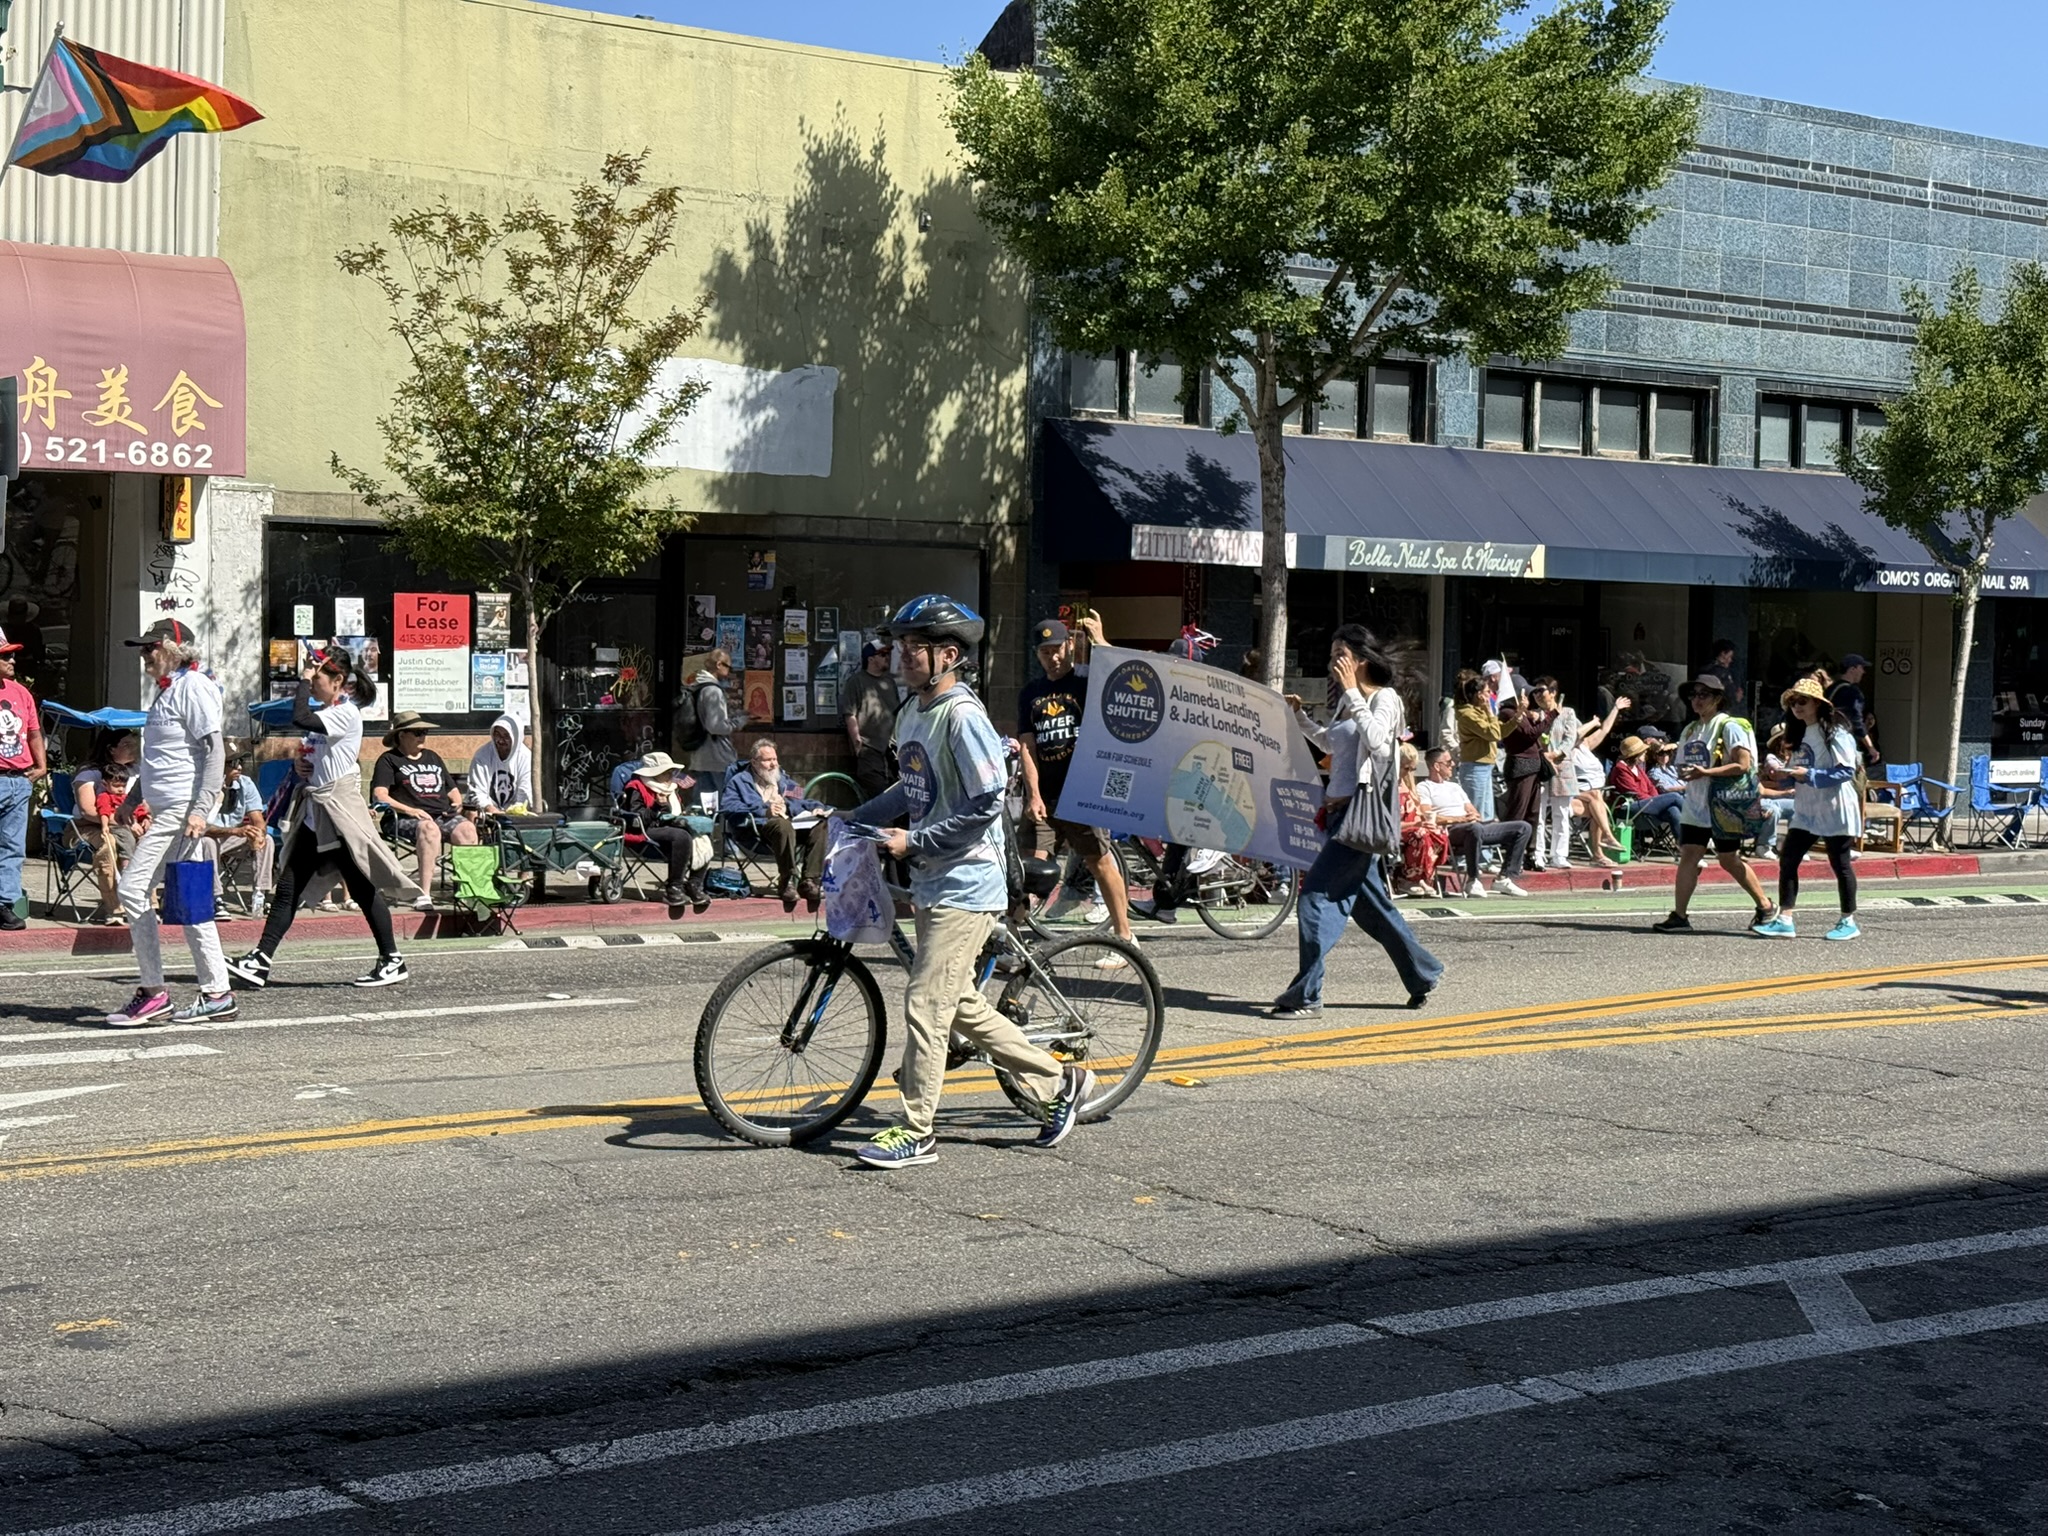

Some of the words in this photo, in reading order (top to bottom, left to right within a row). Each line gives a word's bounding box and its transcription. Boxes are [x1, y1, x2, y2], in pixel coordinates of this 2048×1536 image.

[45, 436, 213, 469] 521-6862
[1138, 532, 1187, 559] LITTLE
[1349, 540, 1393, 568] Bella
[1393, 542, 1429, 570] Nail
[1432, 546, 1457, 573] Spa
[1462, 545, 1474, 570] &
[1476, 546, 1525, 577] Waxing
[1876, 570, 1920, 586] TOMO'S
[1924, 571, 1979, 590] ORGA
[1981, 574, 2006, 590] NAIL
[2010, 575, 2030, 590] SPA
[417, 597, 448, 611] For
[406, 614, 459, 630] Lease
[400, 634, 465, 645] 415.395.7262
[398, 657, 423, 667] Justin
[425, 657, 444, 667] Choi
[398, 677, 413, 687] Jeff
[415, 678, 459, 687] Badstubner
[1114, 691, 1155, 708] WATER
[1169, 684, 1221, 710] Alameda
[1221, 696, 1261, 728] Landing
[1106, 703, 1159, 722] SHUTTLE
[1035, 715, 1075, 732] WATER
[1169, 705, 1180, 722] &
[1182, 708, 1210, 728] Jack
[1211, 713, 1252, 740] London
[1252, 726, 1282, 754] Square
[2020, 717, 2047, 730] Sunday
[1036, 727, 1080, 744] HUTTLE
[2022, 731, 2031, 742] 10
[2031, 733, 2044, 741] am
[399, 764, 419, 776] OLD
[417, 763, 442, 777] NAVY
[1077, 800, 1145, 821] watershuttle.org
